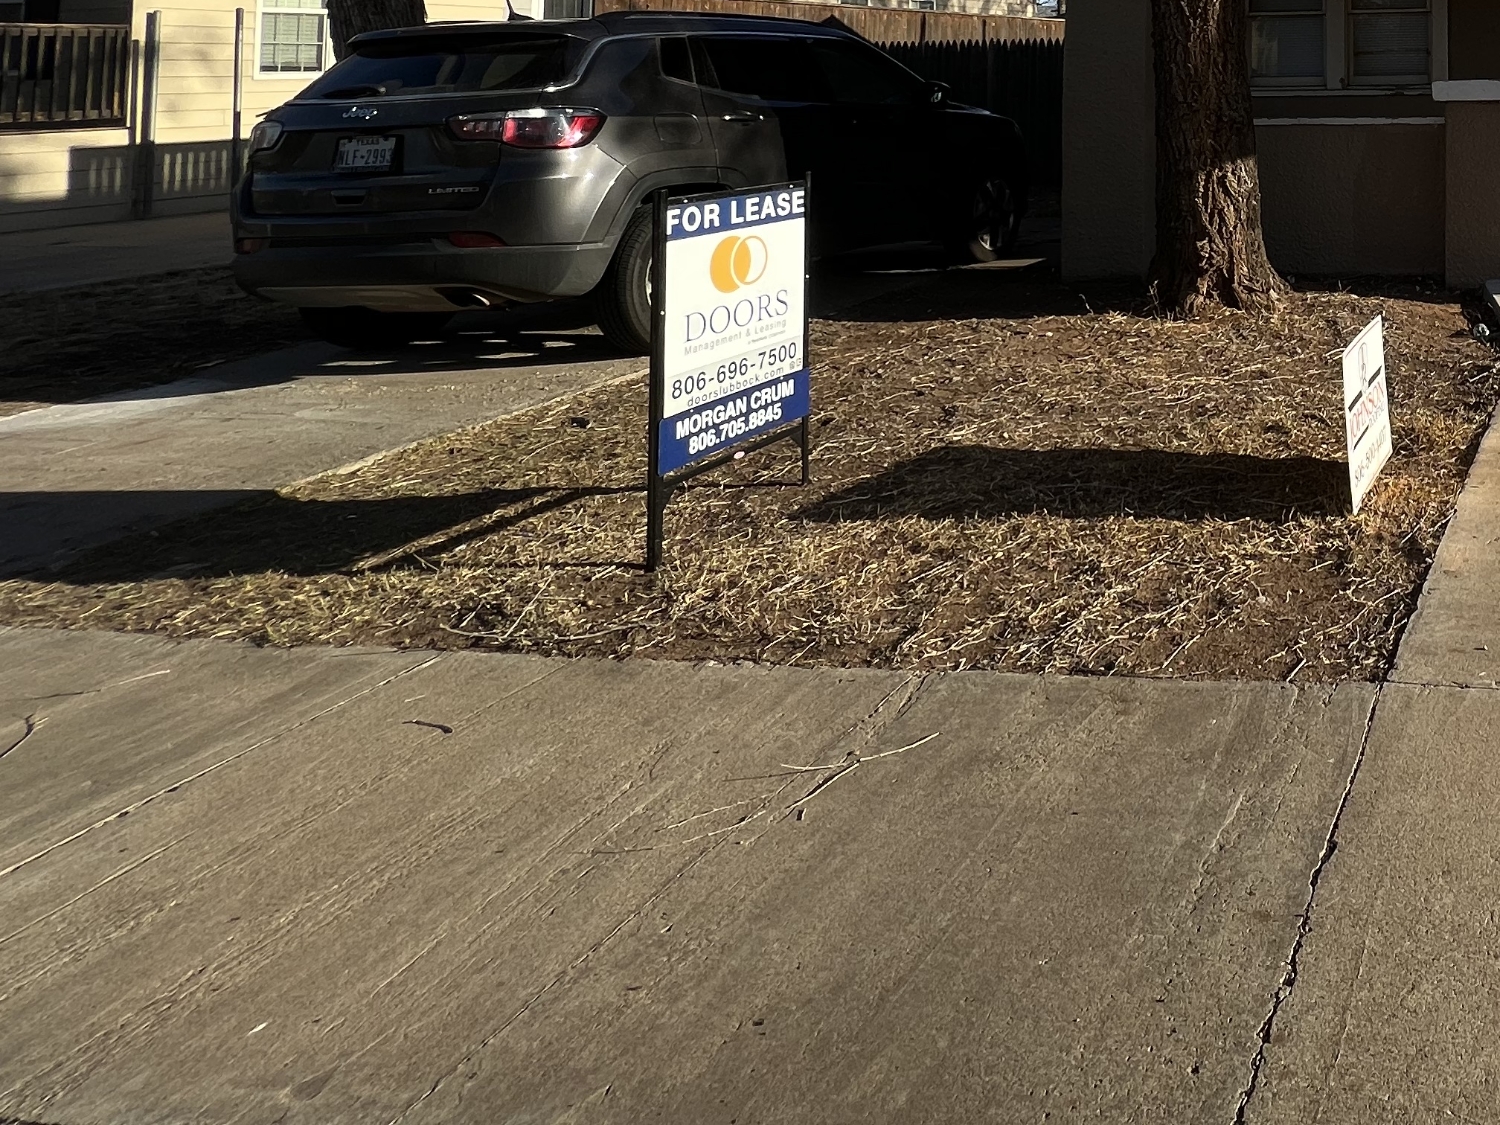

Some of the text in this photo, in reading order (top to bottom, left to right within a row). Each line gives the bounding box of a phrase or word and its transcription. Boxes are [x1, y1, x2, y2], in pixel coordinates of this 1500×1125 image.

[342, 106, 378, 120] Jeep
[428, 186, 480, 194] LIMITED
[666, 190, 805, 236] FOR LEASE
[683, 288, 789, 344] DOORS
[684, 331, 742, 356] Management
[745, 327, 752, 337] &
[754, 319, 787, 335] Leasing
[671, 341, 797, 401] 806-696-7500
[687, 366, 784, 408] doorslubbock.com
[675, 378, 795, 440] MORGAN CRUM
[688, 402, 783, 455] 806.705.8845
[1349, 380, 1385, 451] JOHNSON
